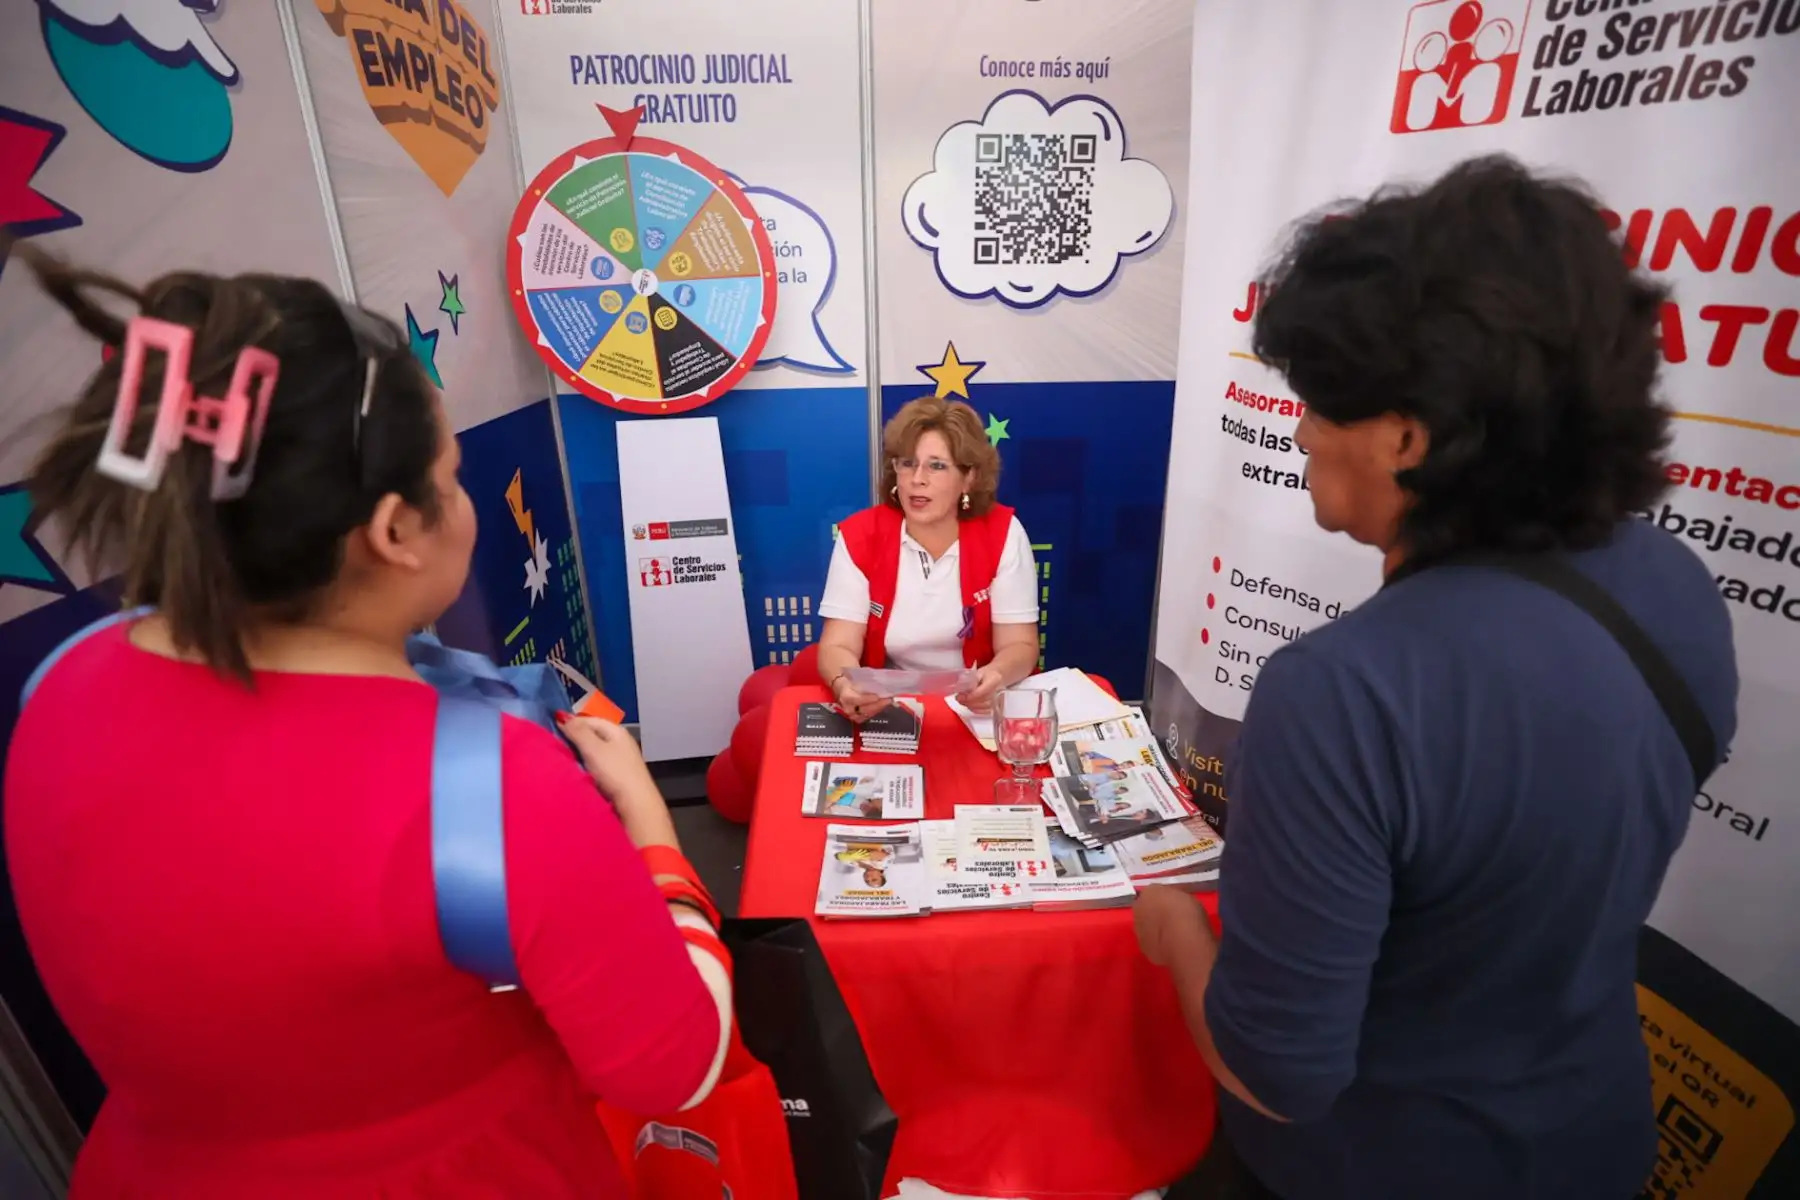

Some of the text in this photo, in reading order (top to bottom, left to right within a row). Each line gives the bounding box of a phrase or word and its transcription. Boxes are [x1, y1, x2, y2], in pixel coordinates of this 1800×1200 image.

[552, 3, 592, 14] Laborales
[1533, 25, 1587, 70] de
[352, 28, 483, 129] EMPLEO
[570, 53, 792, 85] PATROCINIO JUDICIAL
[980, 55, 1110, 83] Conoce más aquí
[1521, 54, 1755, 117] Laborales
[633, 93, 736, 124] GRATUITO
[792, 267, 807, 283] la
[1221, 413, 1292, 452] todas las
[672, 556, 701, 565] Centro
[673, 563, 726, 574] de Servicios
[674, 573, 717, 584] Laborales
[1230, 568, 1320, 613] Defensa
[1218, 640, 1250, 665] Sin
[1215, 666, 1233, 687] D.
[1669, 1036, 1756, 1109] virtual
[1681, 1073, 1719, 1108] QR
